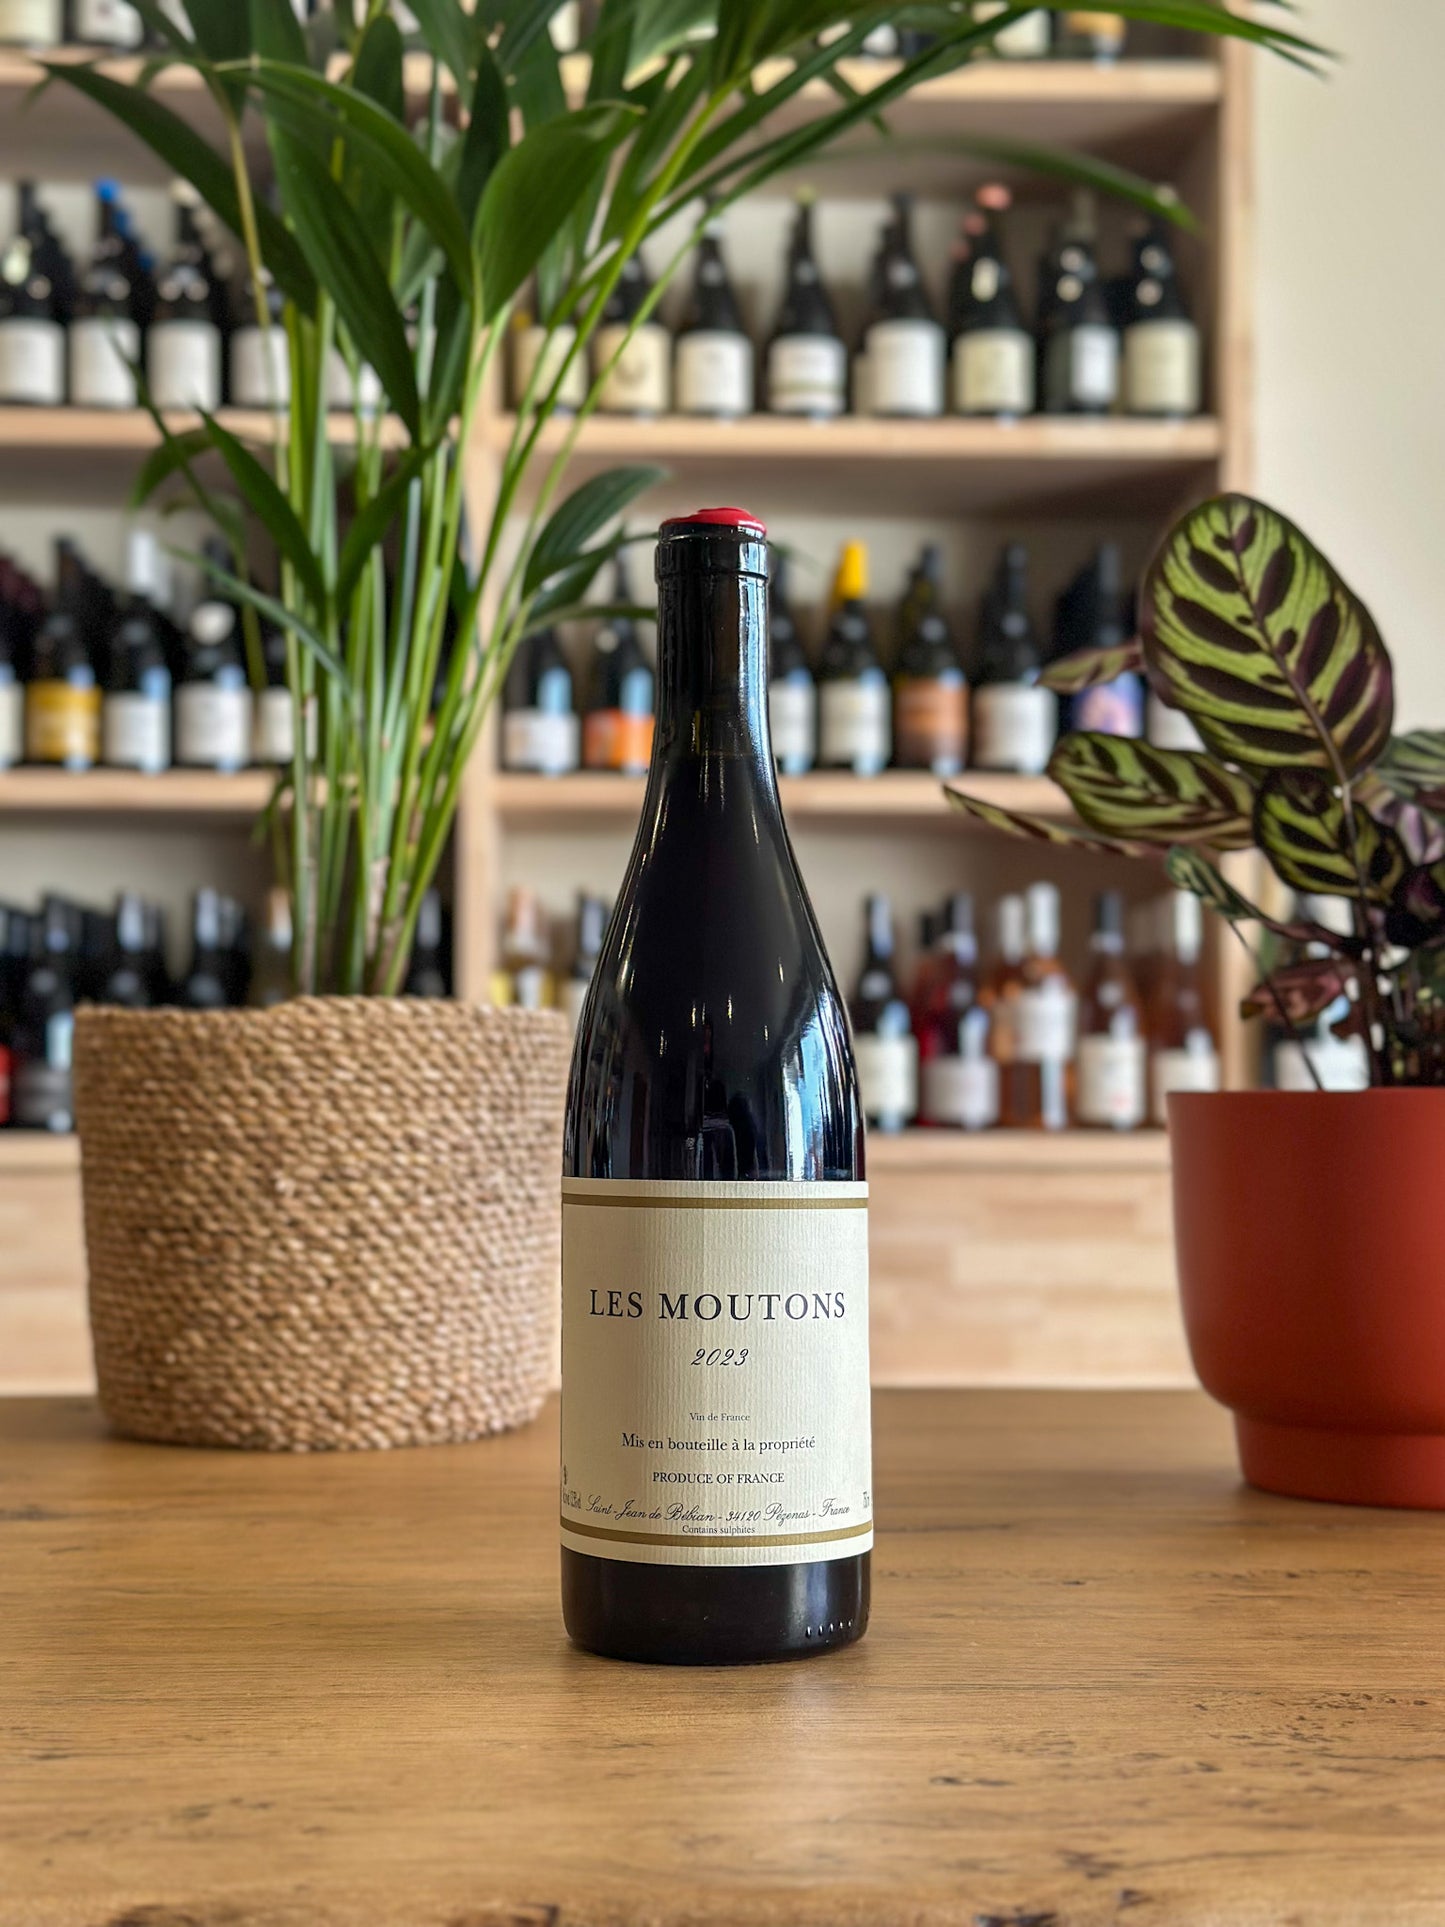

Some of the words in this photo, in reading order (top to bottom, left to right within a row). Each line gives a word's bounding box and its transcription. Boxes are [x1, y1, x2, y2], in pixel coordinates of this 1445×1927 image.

[589, 1289, 644, 1318] LES
[658, 1292, 846, 1321] MOUTONS
[690, 1348, 749, 1366] 2023
[689, 1412, 705, 1421] Vin
[707, 1412, 718, 1421] de
[720, 1412, 750, 1421] France
[622, 1432, 645, 1448] Mis
[648, 1439, 663, 1449] en
[667, 1437, 728, 1451] bouteille
[731, 1438, 740, 1451] à
[743, 1438, 755, 1451] la
[759, 1435, 816, 1455] propriété
[652, 1471, 713, 1484] PRODUCE
[716, 1473, 734, 1484] OF
[737, 1472, 785, 1484] FRANCE
[648, 1507, 661, 1519] de
[664, 1502, 714, 1521] Bébian
[725, 1510, 761, 1522] 34120
[763, 1502, 809, 1527] Pézenas
[818, 1497, 850, 1517] France
[682, 1524, 718, 1534] Contains
[720, 1525, 756, 1536] sulphites
